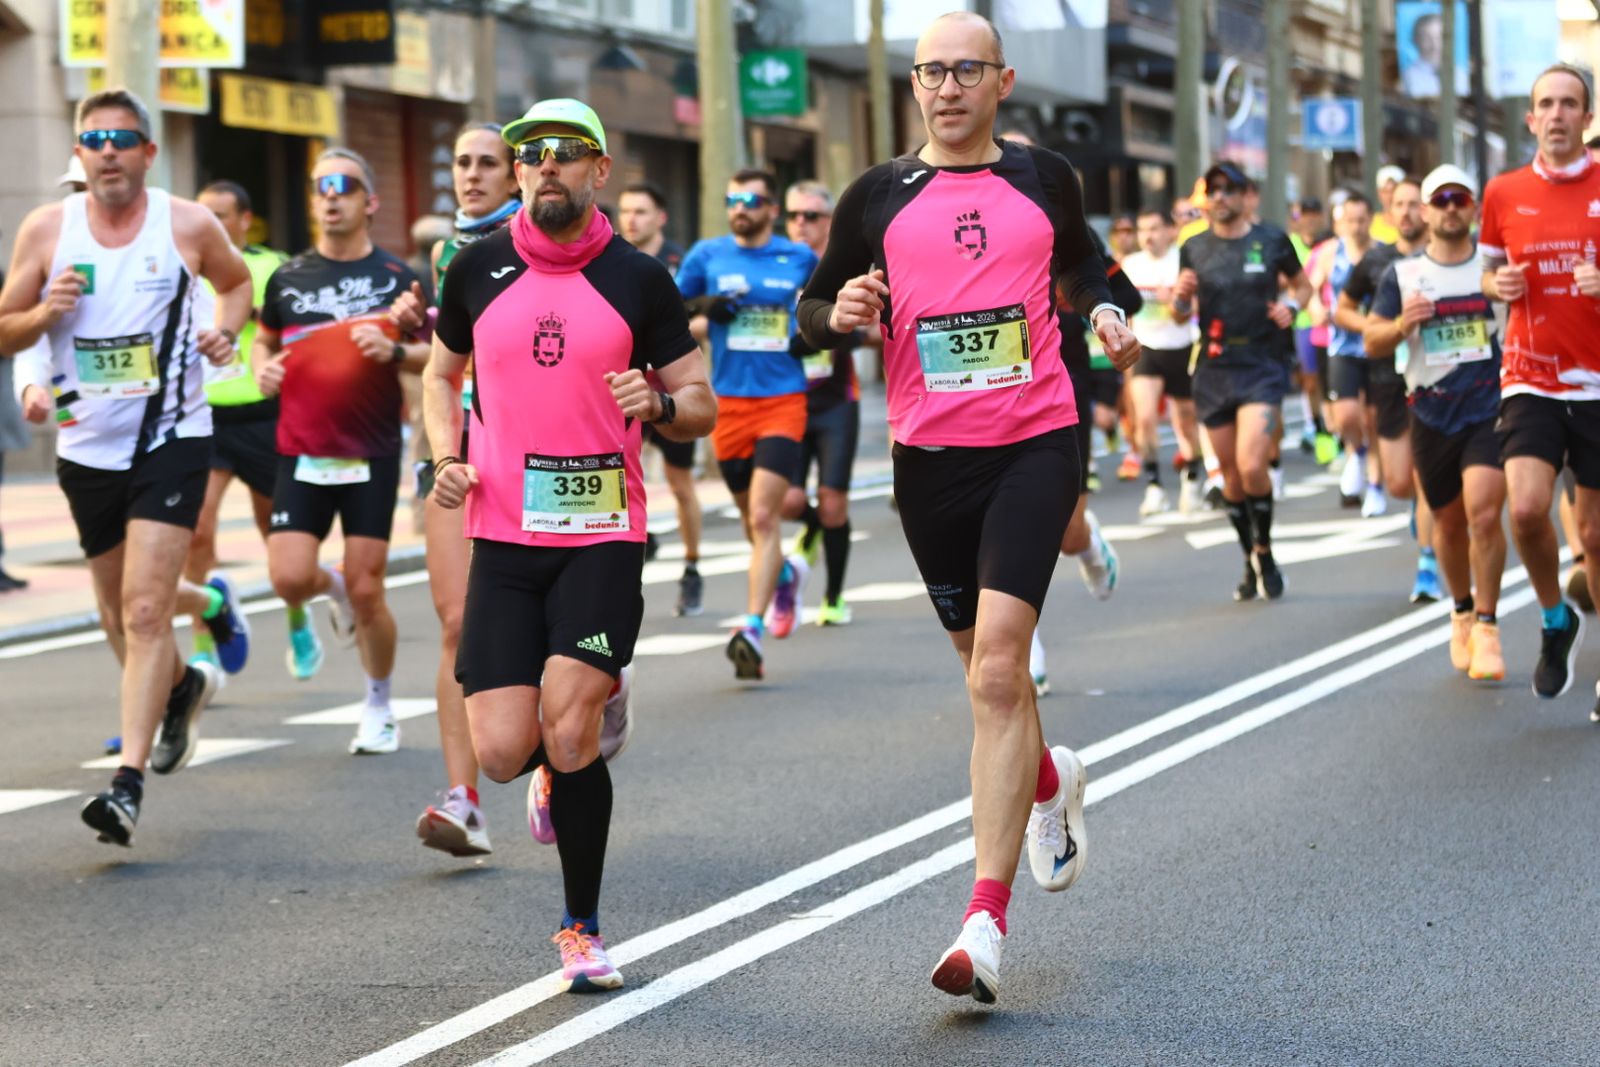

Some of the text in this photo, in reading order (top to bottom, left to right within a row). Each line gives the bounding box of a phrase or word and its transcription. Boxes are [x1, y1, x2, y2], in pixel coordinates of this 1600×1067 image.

[976, 312, 996, 321] 2026
[948, 329, 1000, 354] 337
[1437, 325, 1476, 342] 1265
[94, 352, 133, 370] 312
[962, 356, 990, 364] PABOLO
[553, 475, 602, 496] 339
[577, 641, 612, 657] adidas
